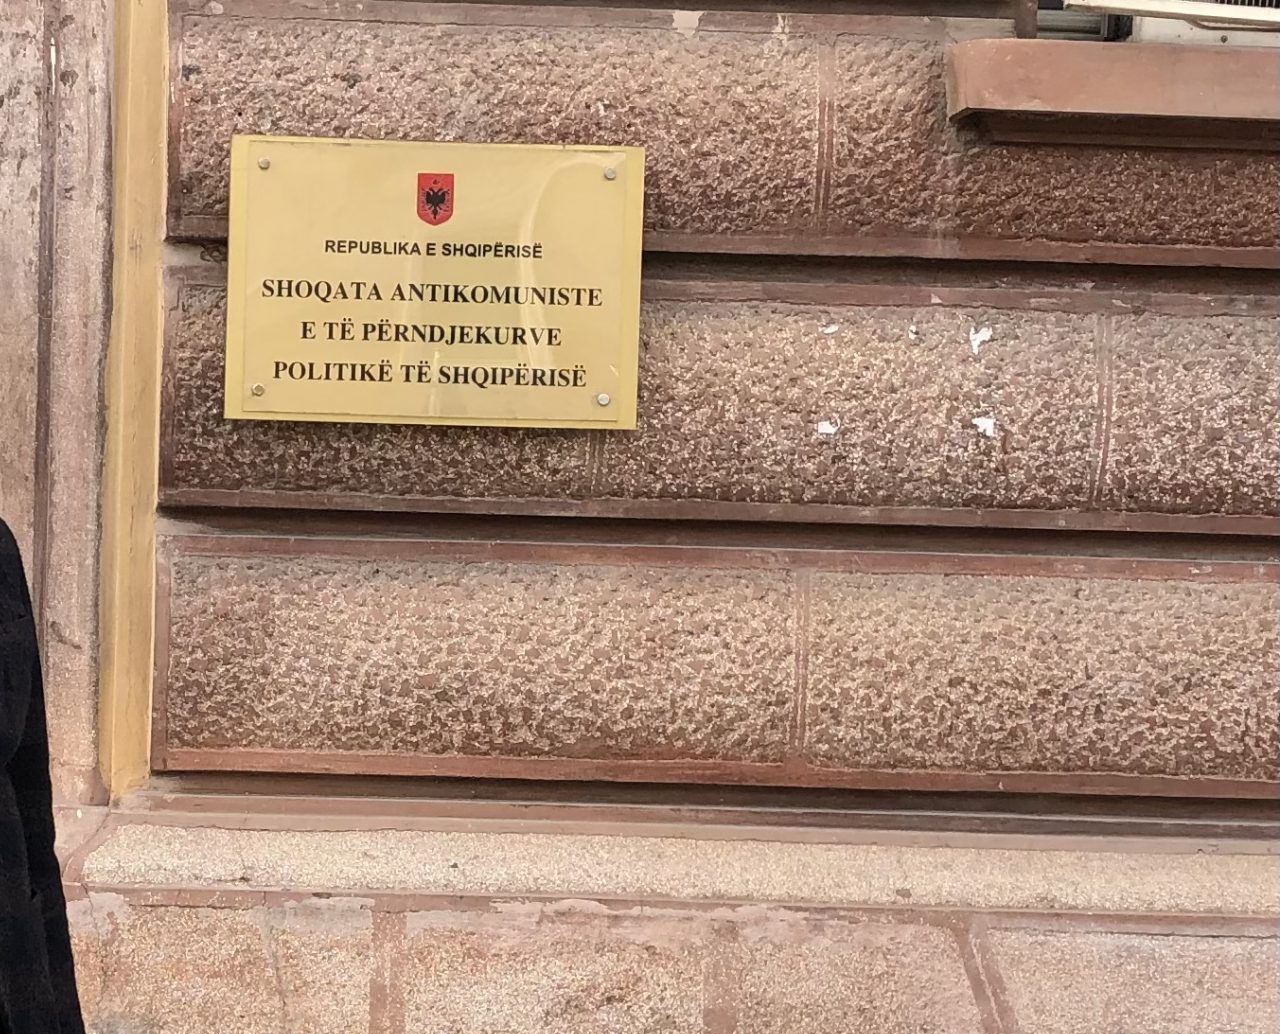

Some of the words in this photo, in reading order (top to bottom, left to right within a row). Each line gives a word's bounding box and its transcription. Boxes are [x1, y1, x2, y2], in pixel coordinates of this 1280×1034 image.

[325, 240, 421, 256] REPUBLIKA
[426, 243, 436, 256] E
[441, 241, 543, 259] SHQIPËRISË
[261, 279, 382, 302] SHOQATA
[391, 284, 603, 306] ANTIKOMUNISTE
[301, 321, 316, 339] E
[323, 318, 355, 341] TË
[362, 319, 562, 346] PËRNDJEKURVE
[273, 360, 392, 383] POLITIKË
[400, 361, 431, 384] TË
[438, 364, 587, 389] SHQIPËRISË
